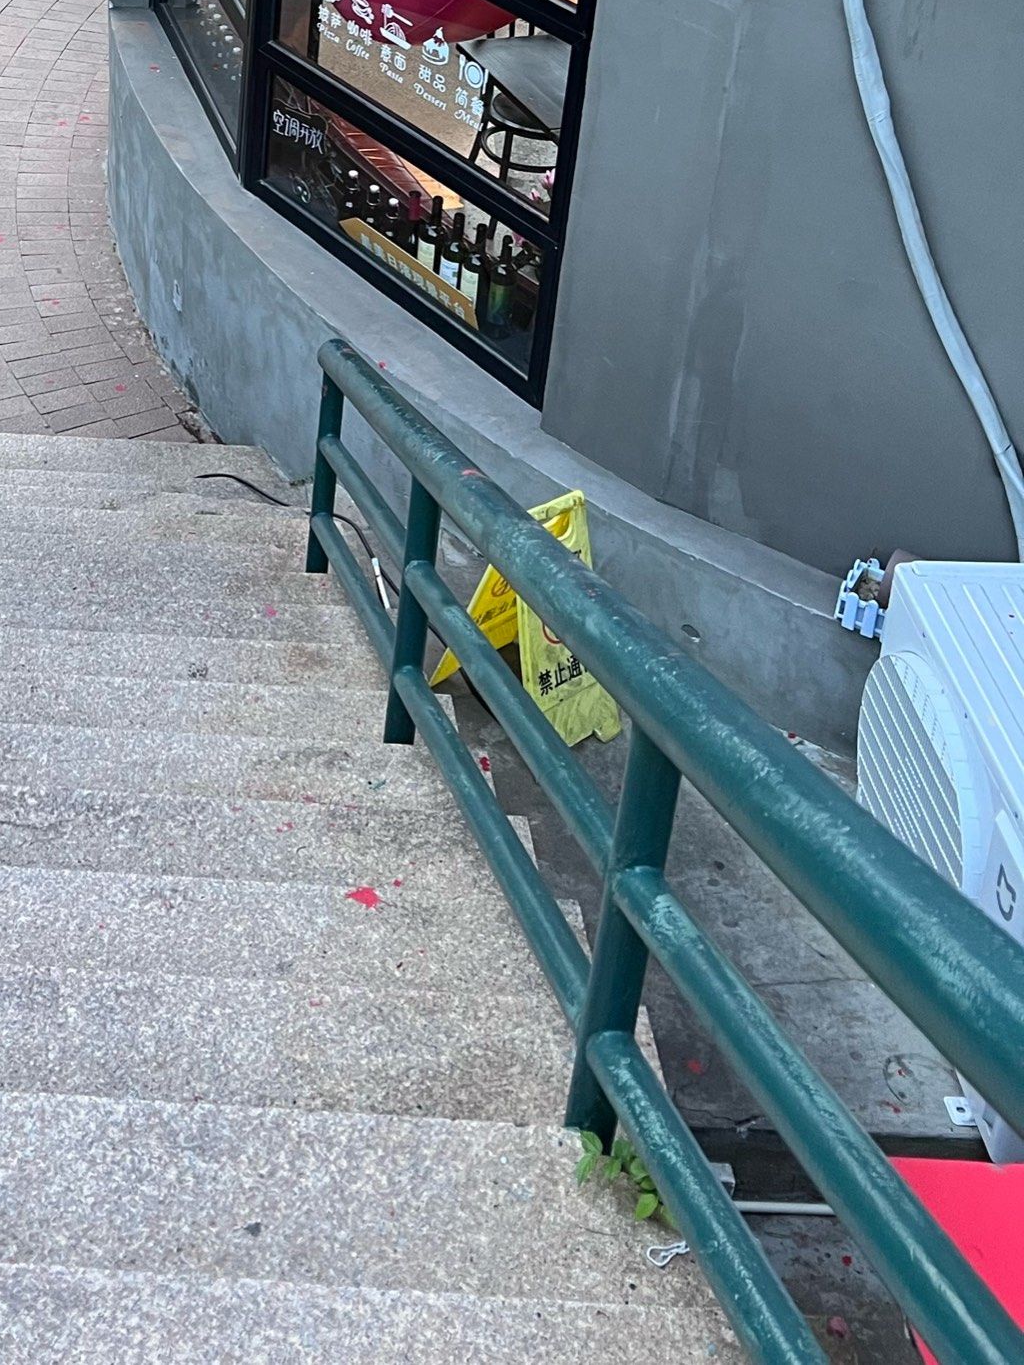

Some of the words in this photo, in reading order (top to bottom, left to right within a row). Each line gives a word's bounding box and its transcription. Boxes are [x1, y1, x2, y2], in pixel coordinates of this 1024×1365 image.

[345, 38, 371, 61] Coffee
[379, 62, 404, 84] Pasta
[413, 82, 448, 111] Dessert
[346, 20, 373, 47] 咖啡
[380, 44, 407, 71] 意面
[417, 64, 446, 93] 甜品
[272, 109, 324, 155] 空调开放
[538, 655, 588, 697] 禁止通
